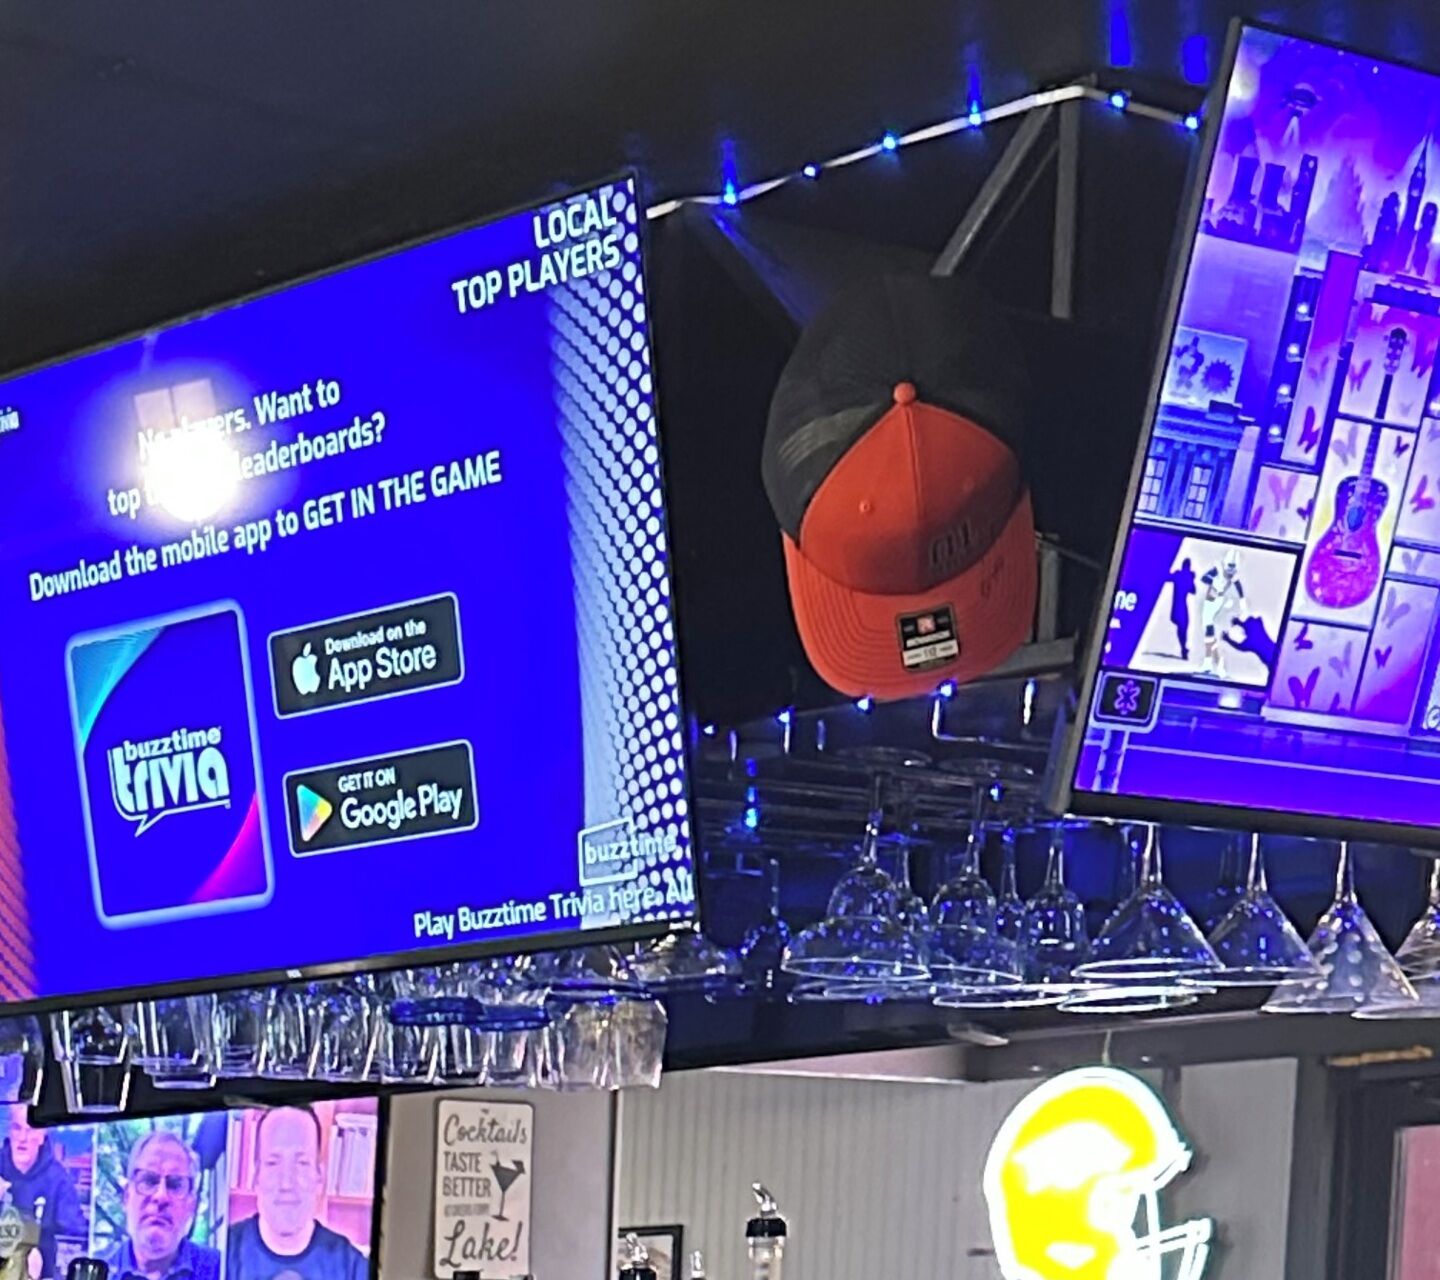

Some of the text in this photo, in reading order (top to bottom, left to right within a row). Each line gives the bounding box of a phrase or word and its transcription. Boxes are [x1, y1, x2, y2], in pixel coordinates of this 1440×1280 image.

[533, 195, 617, 248] LOCAL
[452, 234, 621, 314] TOP PLAYERS
[254, 384, 314, 426] Want
[316, 379, 340, 409] to
[108, 412, 386, 520] top leaderboards?
[29, 450, 502, 602] Download the mobile app to GET IN THE GAME
[324, 619, 427, 656] Download on the
[328, 644, 437, 693] App Store
[123, 727, 221, 762] buzztime
[338, 766, 396, 793] GET IT ON
[340, 783, 464, 831] Google Play
[585, 832, 677, 865] buzztime
[414, 911, 454, 940] Play
[458, 899, 546, 933] Buzztime
[549, 890, 605, 920] Trivia
[443, 1113, 528, 1147] Cocktails
[443, 1150, 482, 1174] TASTE
[442, 1176, 492, 1199] BETTER
[439, 1219, 524, 1269] Lake!
